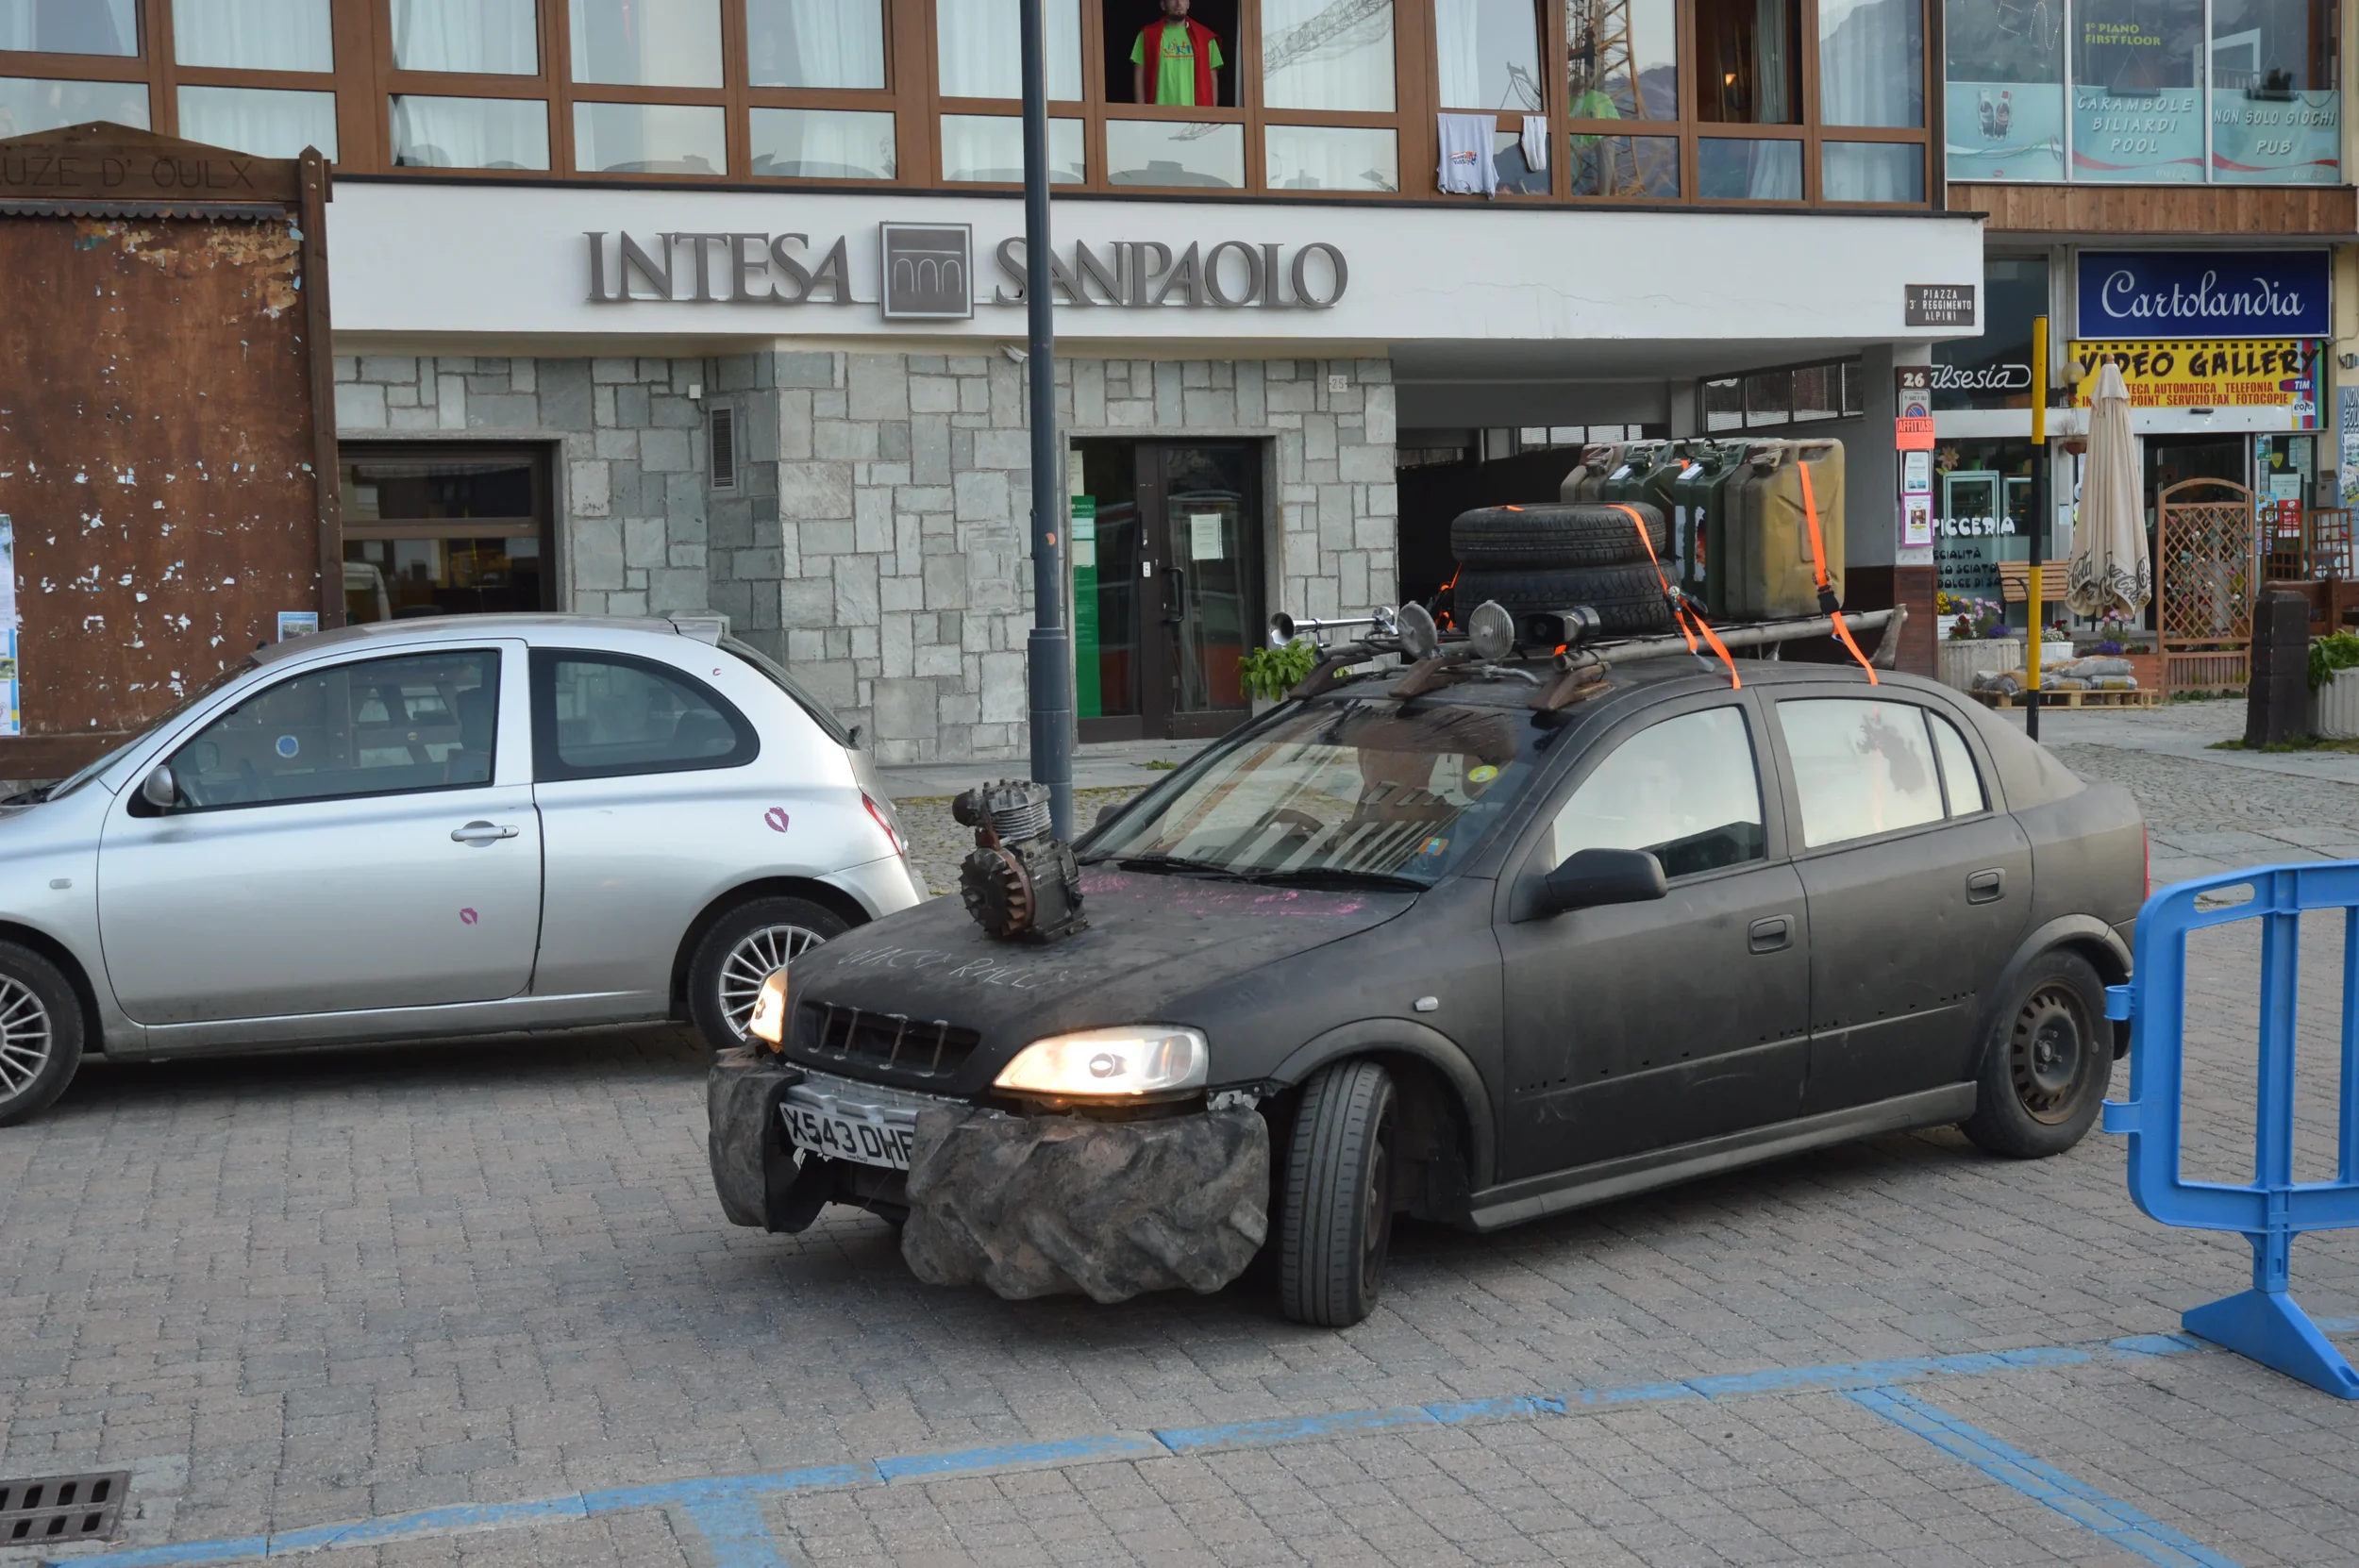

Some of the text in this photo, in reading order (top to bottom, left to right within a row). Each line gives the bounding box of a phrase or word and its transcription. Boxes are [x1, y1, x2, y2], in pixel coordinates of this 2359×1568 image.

[2099, 24, 2140, 33] PIANO
[2085, 34, 2161, 45] FIRST FLOOR
[2077, 96, 2194, 112] CARAMBOLE
[2214, 108, 2337, 127] NON SOLO GIOCHI
[2092, 118, 2178, 133] BILIARDI
[2110, 139, 2159, 154] POOL
[2255, 141, 2293, 155] PUB
[0, 157, 81, 187] UZE
[151, 158, 255, 189] OULX
[582, 230, 1349, 309] INTESA SANPAOLO
[1923, 289, 1958, 299] PIAZZA
[2101, 270, 2305, 318] Cartolandia
[1922, 300, 1972, 310] REGGIMENTO
[1925, 311, 1957, 321] ALPINI
[2188, 348, 2320, 378] GALLERY
[1331, 377, 1345, 390] 25
[1903, 373, 1926, 388] 26
[2294, 381, 2311, 391] TIM
[2127, 382, 2273, 394] TECA AUTOMATICA TELEFONIA
[2131, 394, 2160, 407] POINT
[2167, 393, 2211, 406] SERVIZIO
[2213, 393, 2230, 405] FAX
[2235, 392, 2288, 405] FOTOCOPIE
[1898, 420, 1932, 432] AFFITTASI
[1932, 547, 1982, 560] ECIALITÀ
[1956, 564, 1999, 575] SCIATO
[1973, 577, 1983, 589] DI
[783, 1108, 857, 1154] X543
